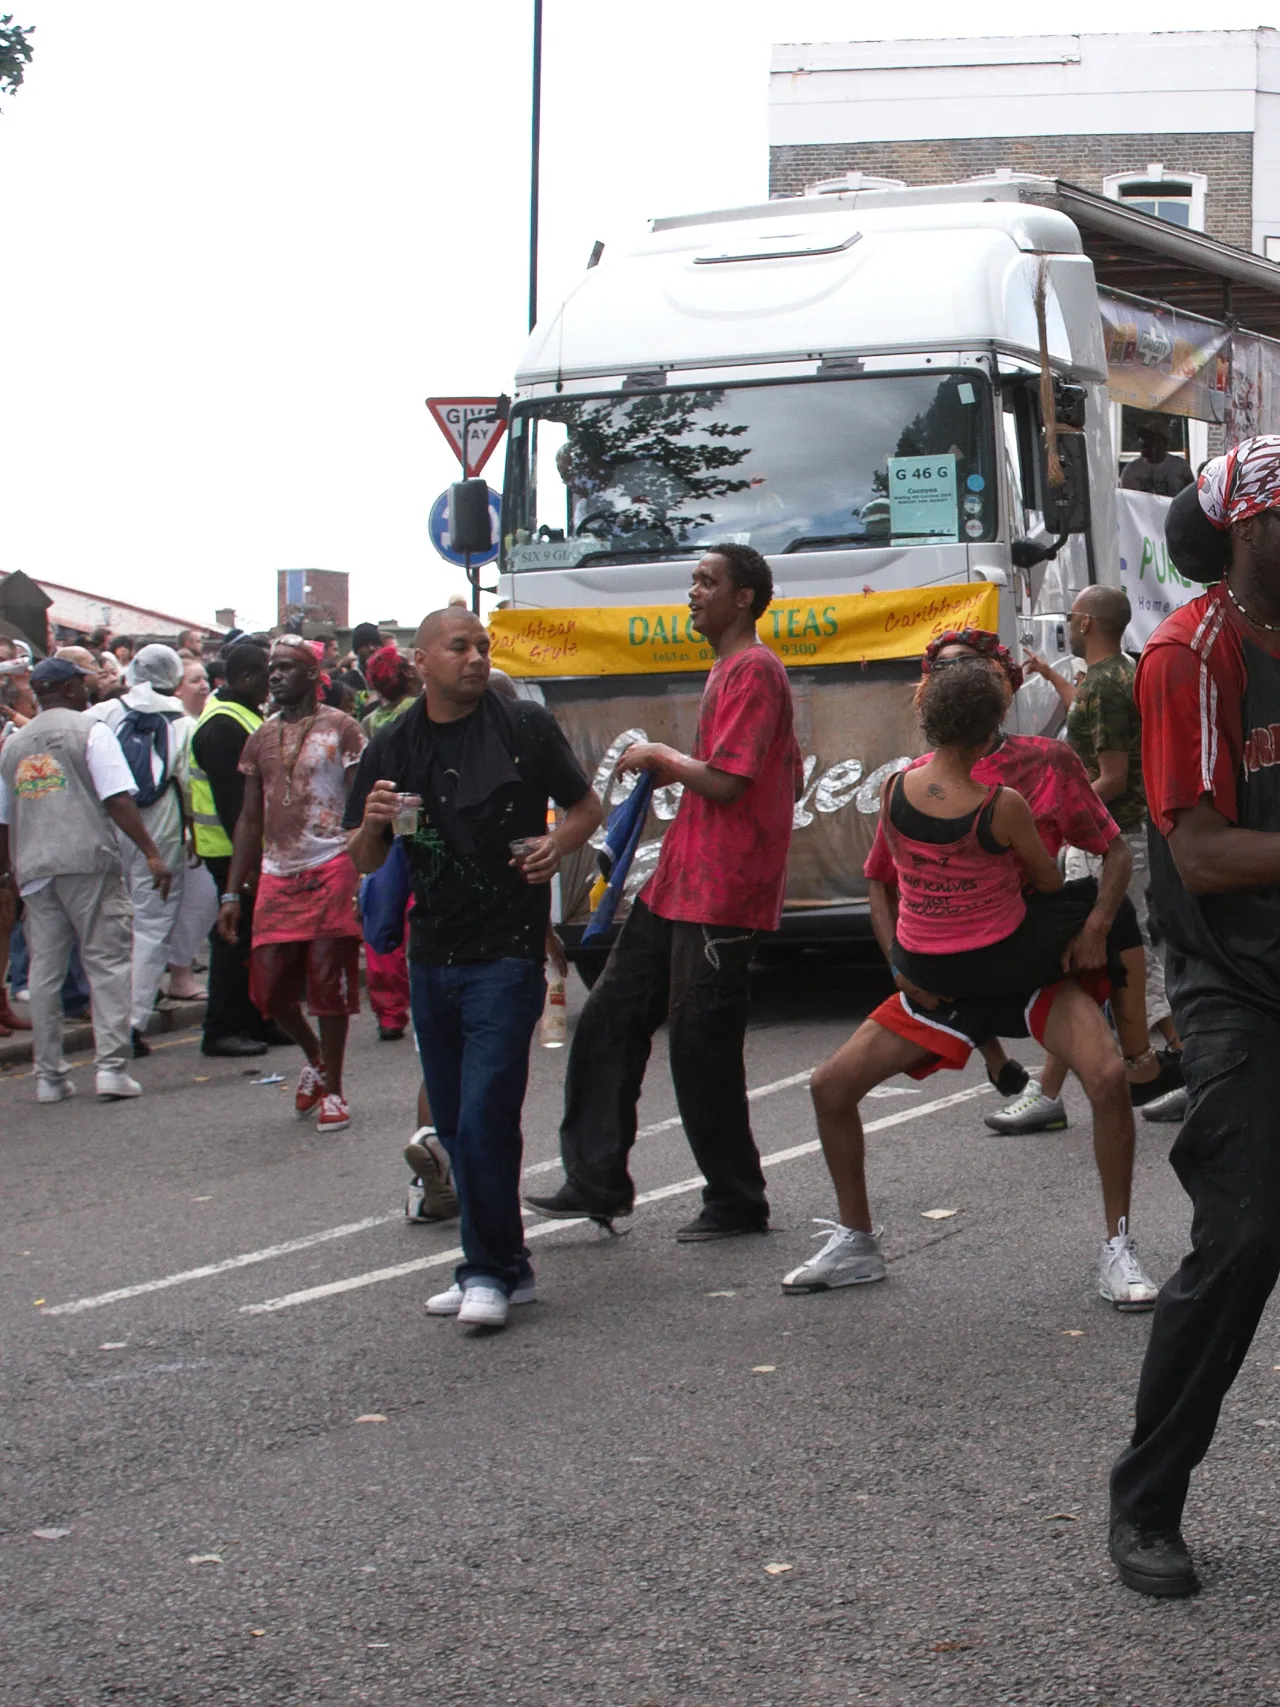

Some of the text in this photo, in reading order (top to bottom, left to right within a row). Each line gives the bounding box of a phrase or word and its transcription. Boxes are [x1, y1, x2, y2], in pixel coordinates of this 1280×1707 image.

[446, 408, 497, 424] GIVE
[896, 466, 948, 480] G 46 G
[1139, 536, 1193, 588] PUR
[1138, 595, 1171, 613] Home
[768, 605, 839, 639] TEAS
[885, 593, 985, 633] Caribbean
[781, 642, 818, 657] 9300
